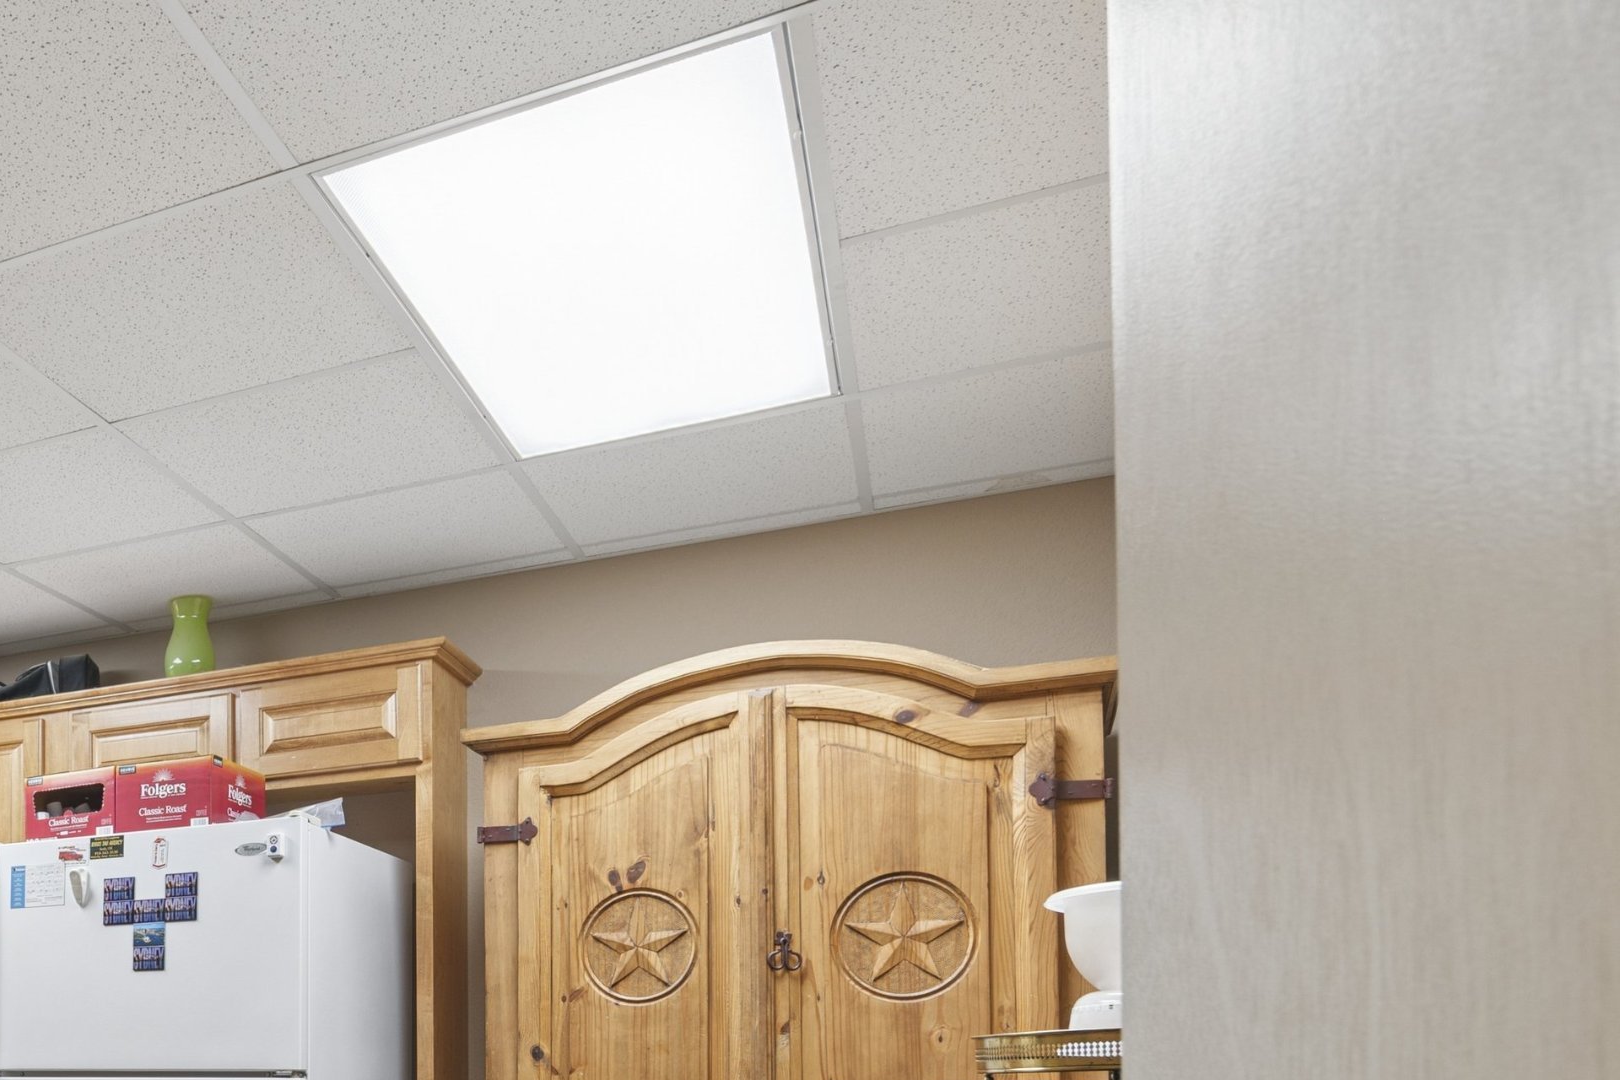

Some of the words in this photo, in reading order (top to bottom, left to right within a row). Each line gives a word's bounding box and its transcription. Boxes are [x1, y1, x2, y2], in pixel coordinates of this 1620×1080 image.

[140, 783, 186, 798] Folgers
[228, 784, 252, 806] Folgers
[139, 806, 164, 816] Classic
[165, 804, 187, 814] Roast
[49, 818, 70, 826] Classic
[71, 815, 89, 824] Roast
